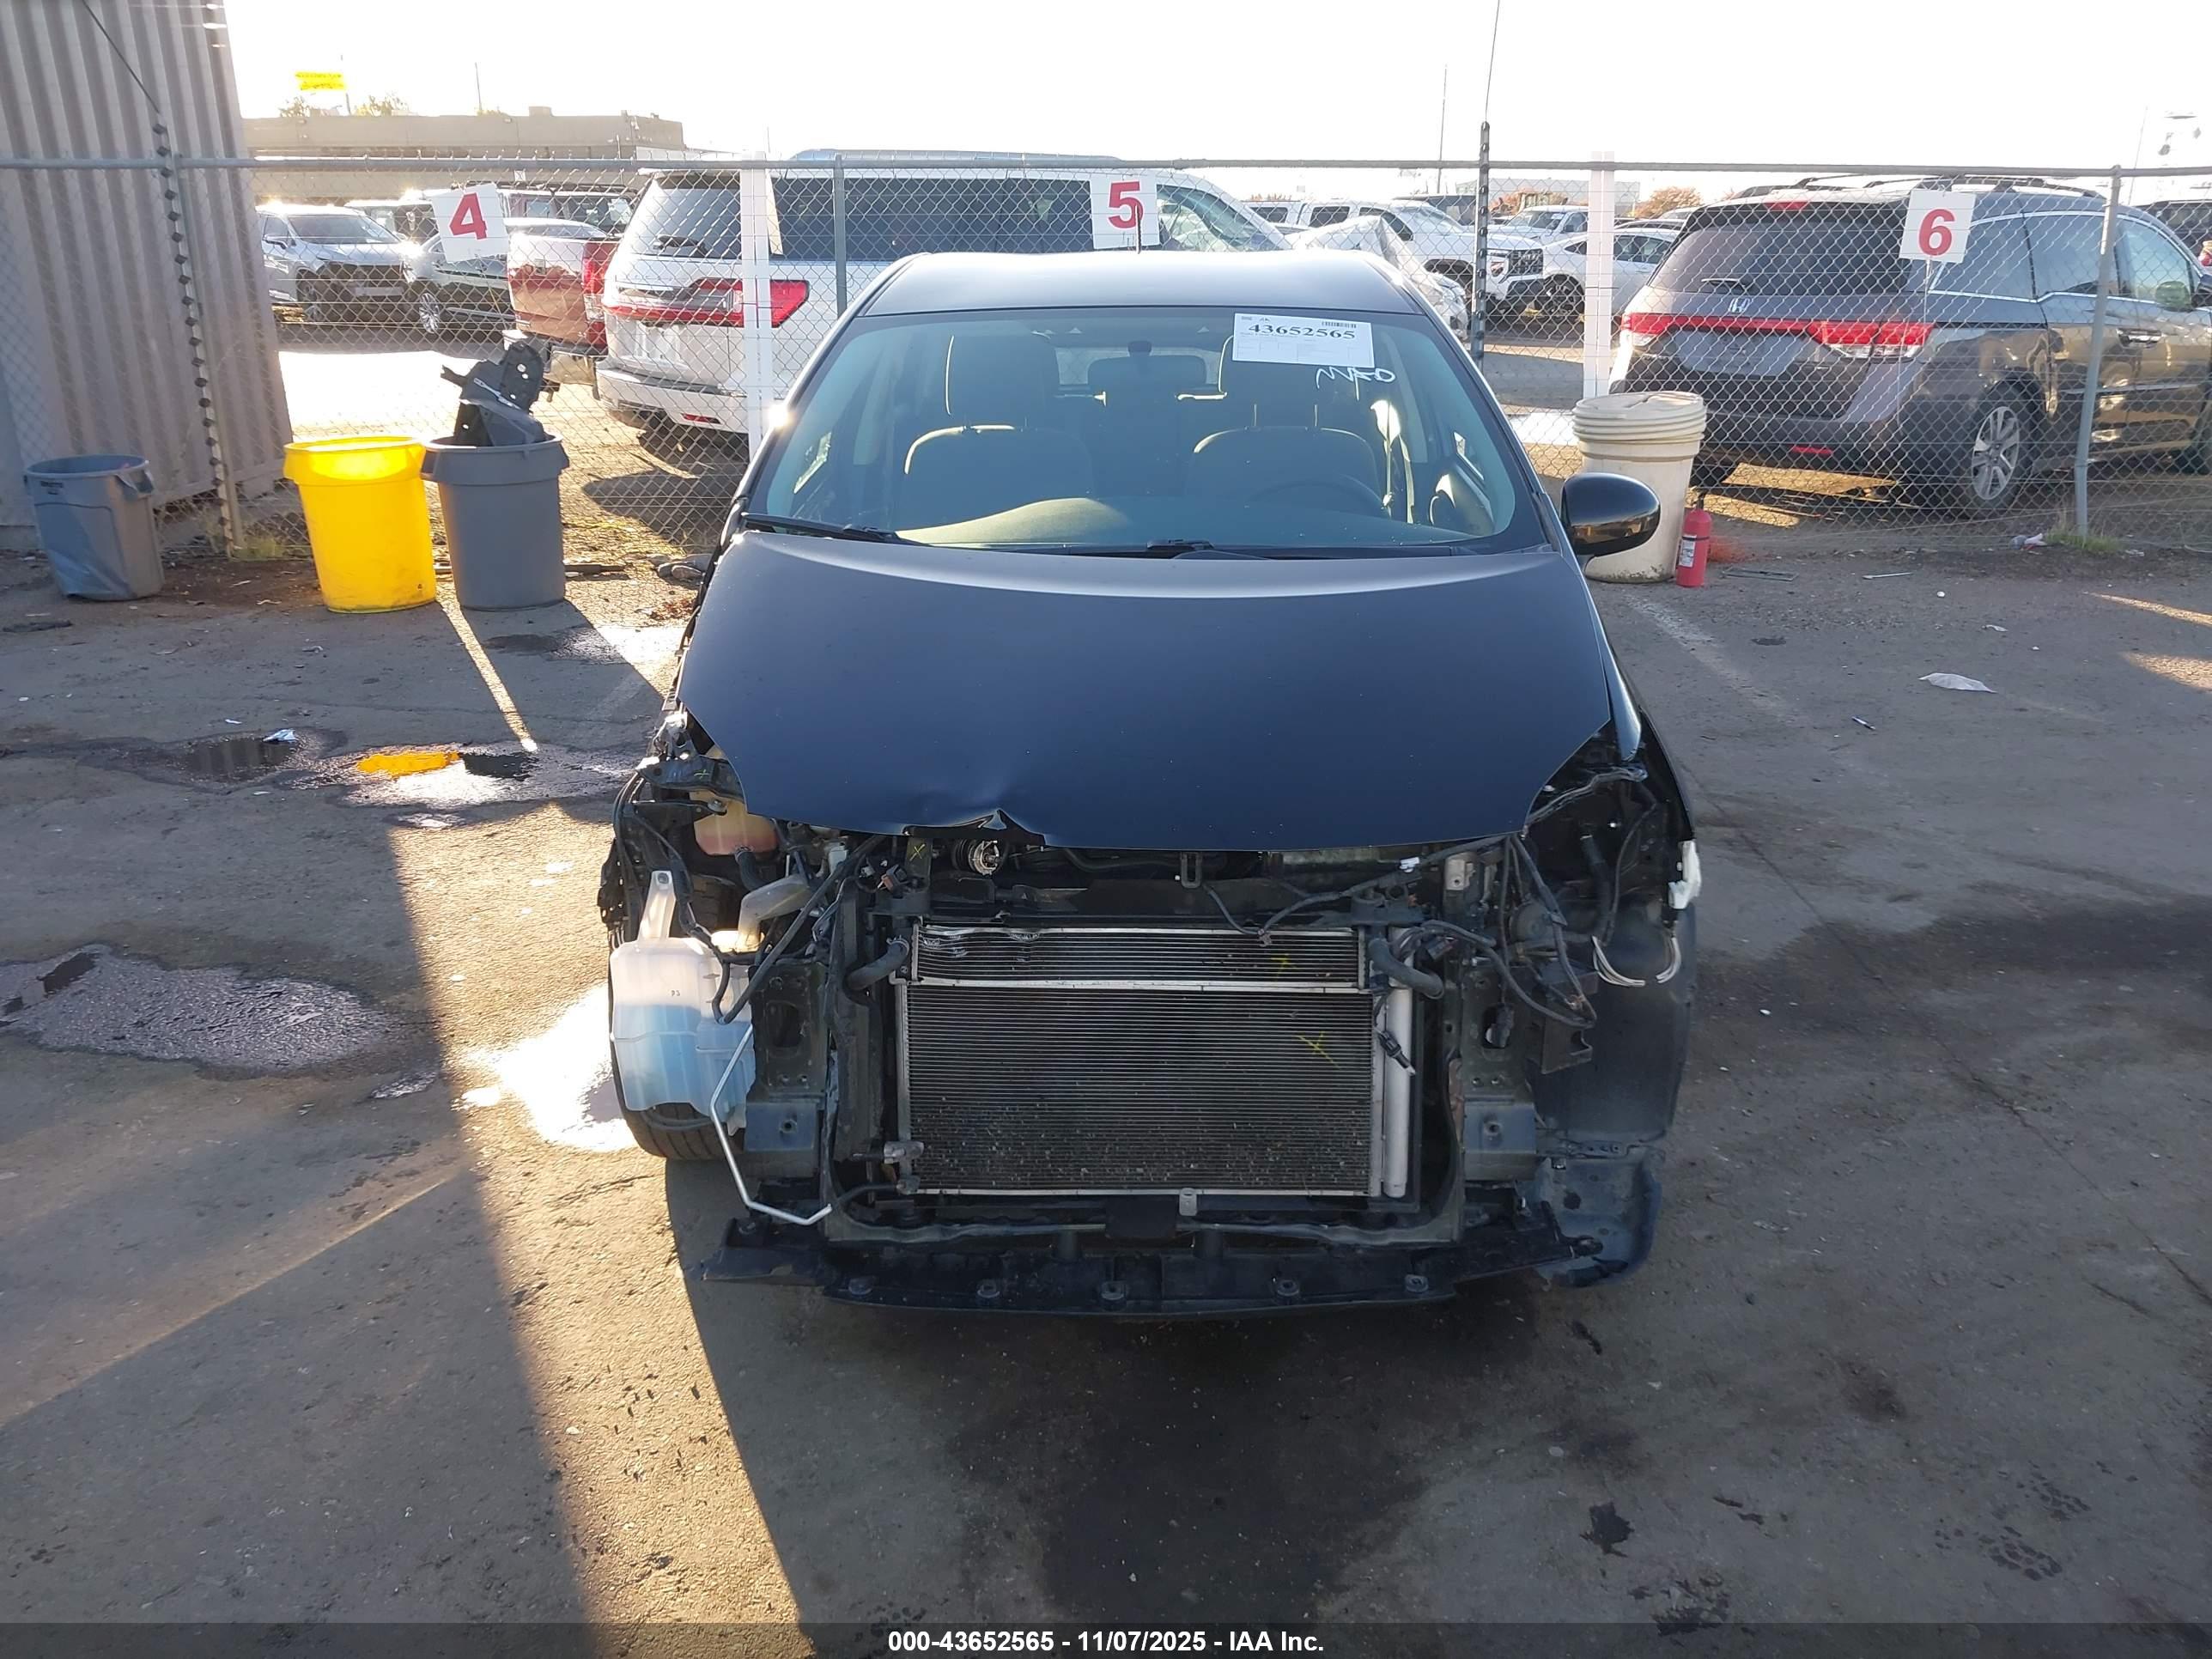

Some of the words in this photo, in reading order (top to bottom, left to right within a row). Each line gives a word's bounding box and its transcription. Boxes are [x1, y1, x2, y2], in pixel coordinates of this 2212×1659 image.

[449, 192, 488, 240] 4
[1108, 180, 1144, 229] 5
[1918, 209, 1955, 256] 6
[1248, 323, 1356, 340] 43652565
